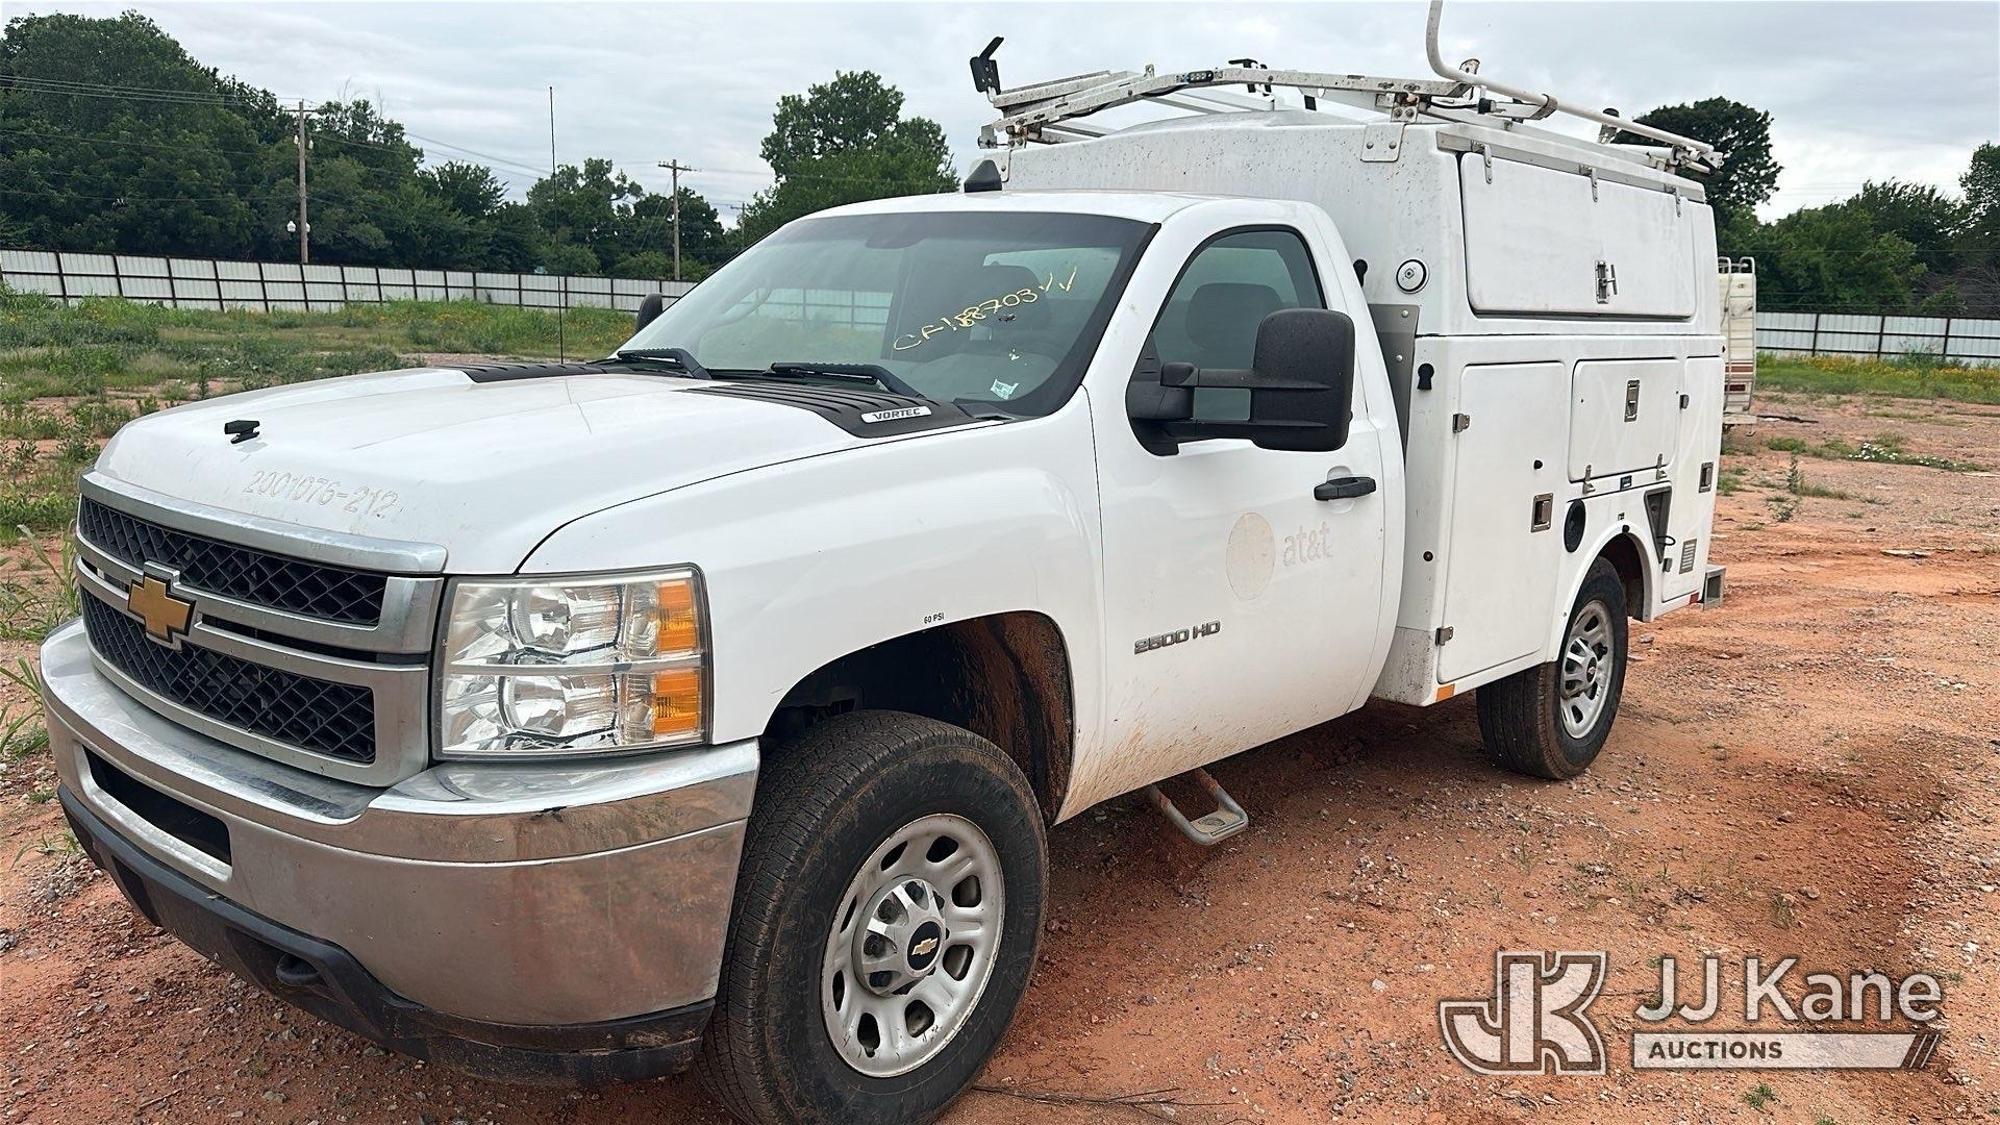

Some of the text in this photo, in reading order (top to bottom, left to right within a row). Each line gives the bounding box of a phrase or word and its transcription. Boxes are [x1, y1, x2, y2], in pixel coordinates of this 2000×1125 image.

[872, 407, 921, 421] VORTEC
[1283, 521, 1334, 567] at&t
[933, 612, 945, 622] PSI
[1134, 620, 1221, 655] 2500 HD
